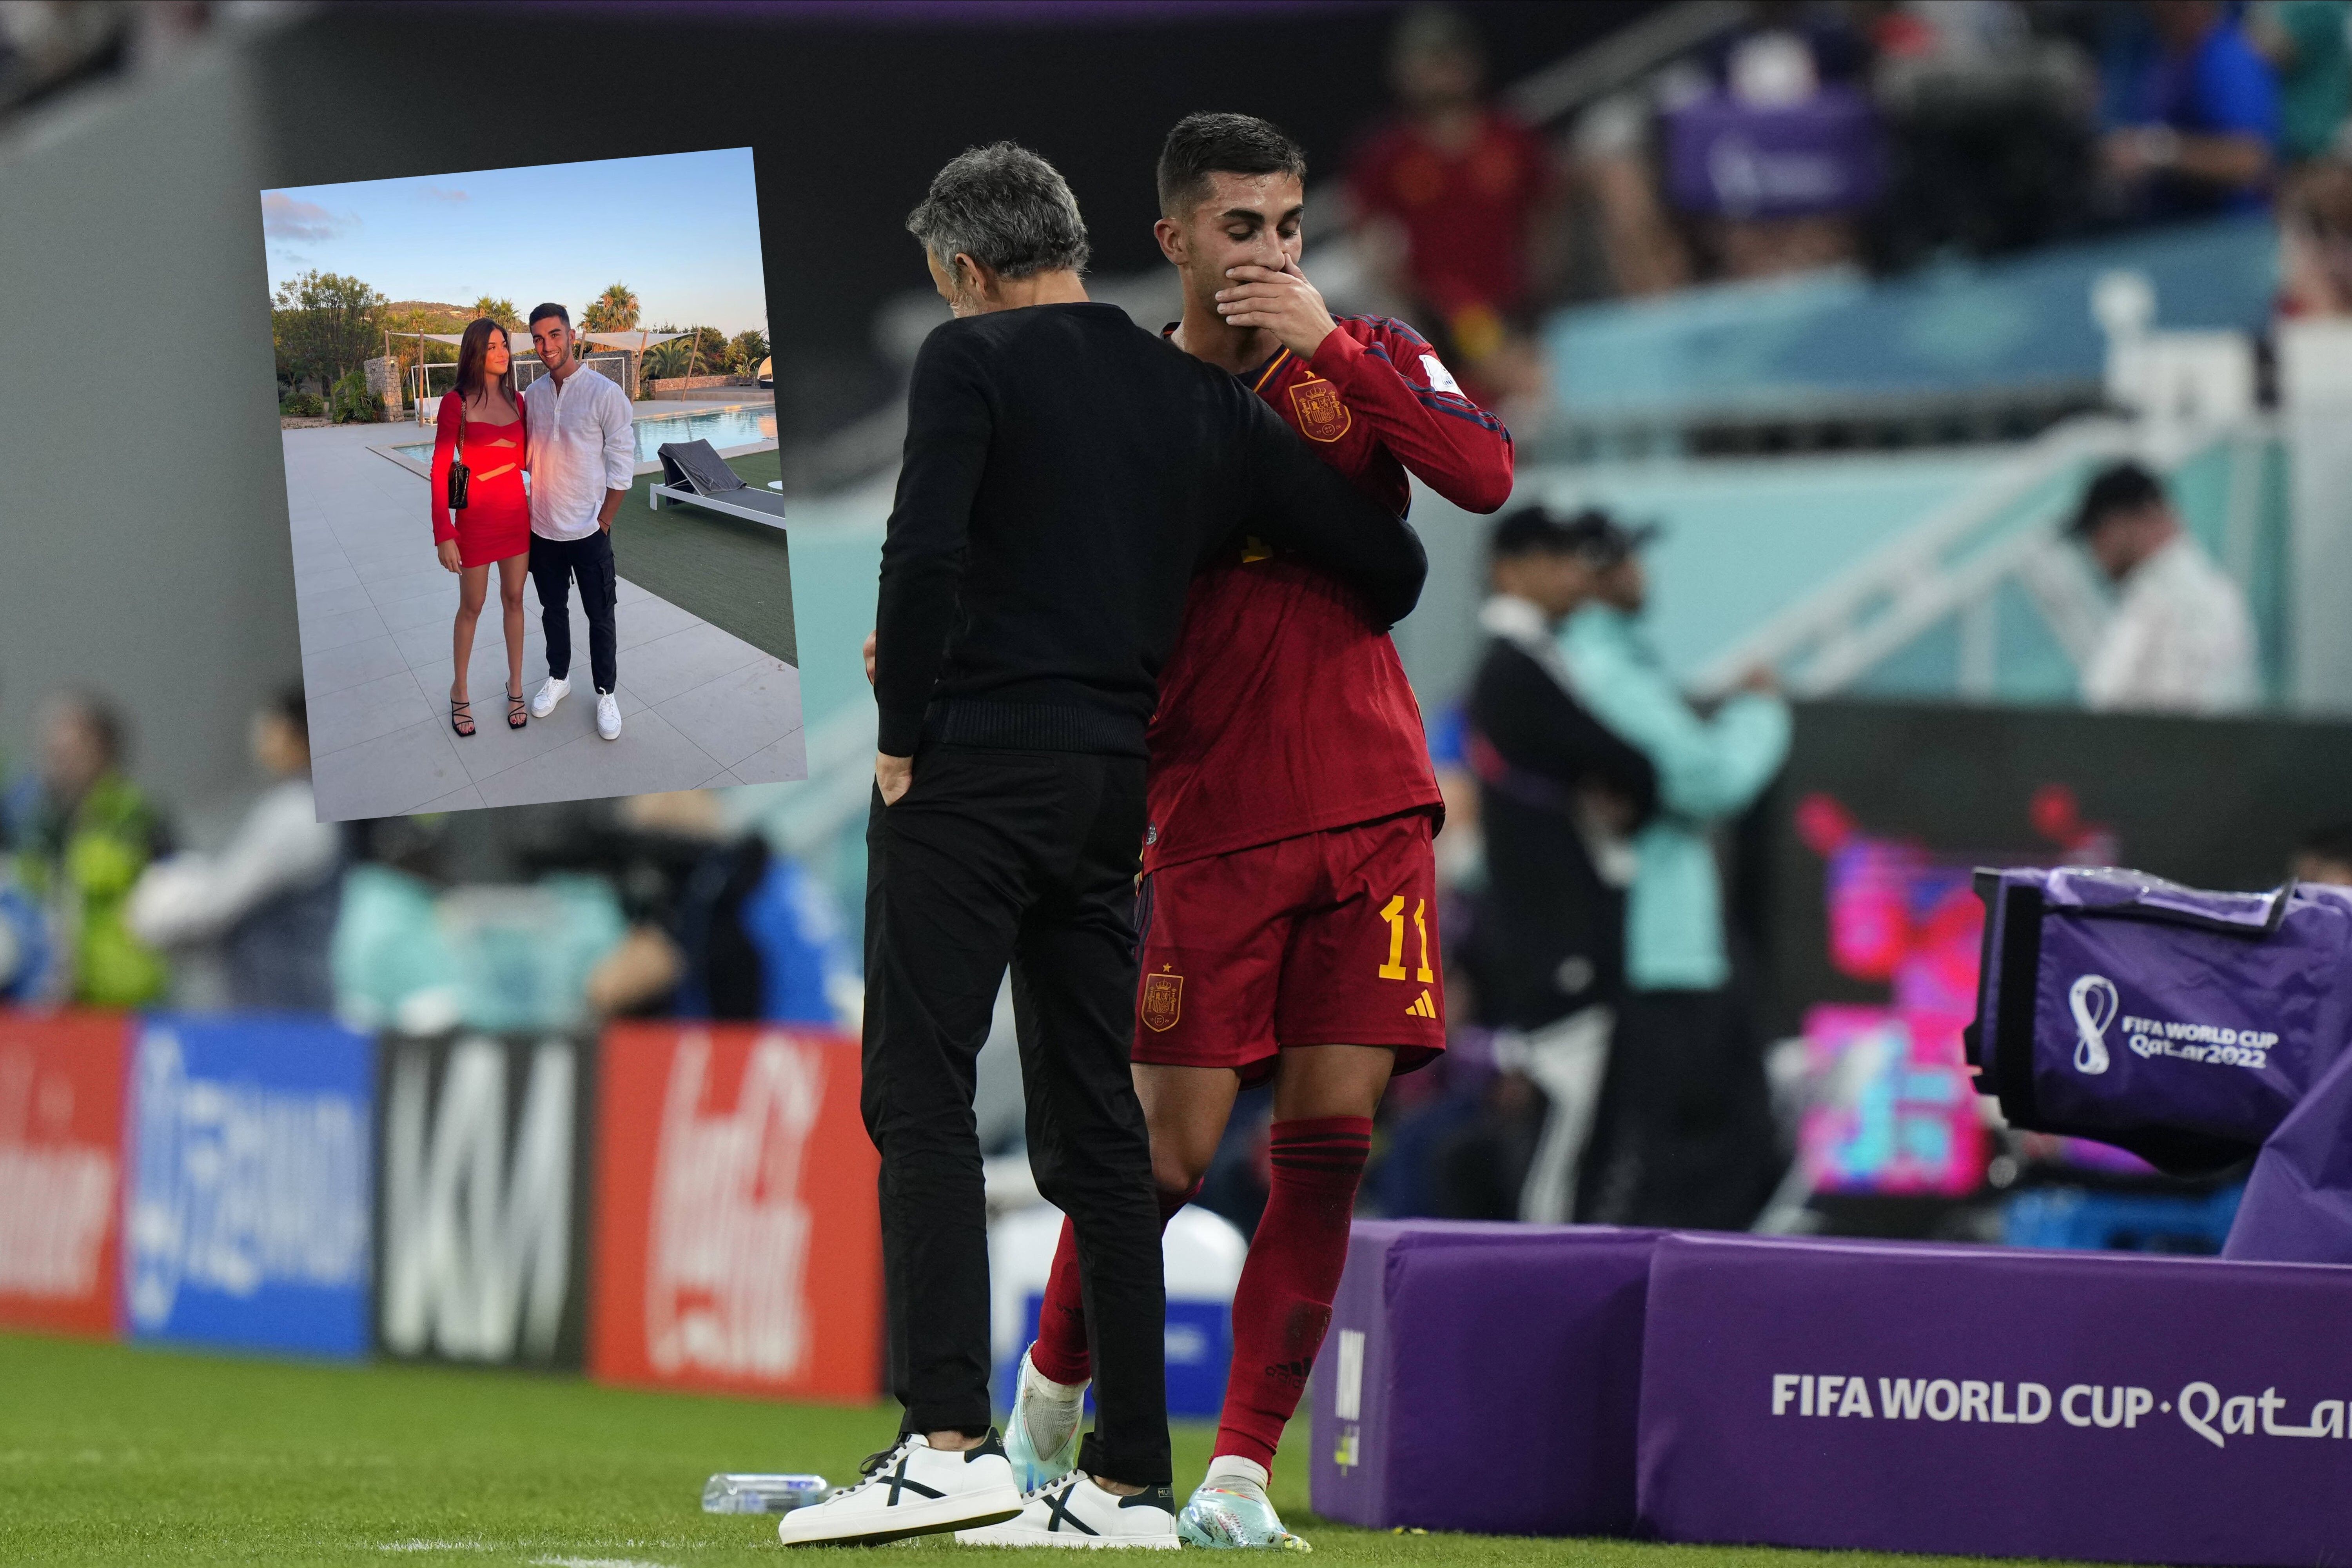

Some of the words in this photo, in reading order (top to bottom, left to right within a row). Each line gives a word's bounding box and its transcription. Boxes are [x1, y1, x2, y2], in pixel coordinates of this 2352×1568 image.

[1379, 895, 1434, 984] 11
[2122, 1016, 2164, 1036] FIFA
[2165, 1022, 2237, 1045] WORLD
[2238, 1030, 2279, 1049] CUP
[1772, 1374, 1874, 1418] FIFA
[1878, 1377, 2053, 1425] WORLD
[2060, 1384, 2154, 1428] CUP
[2178, 1381, 2352, 1448] Qata
